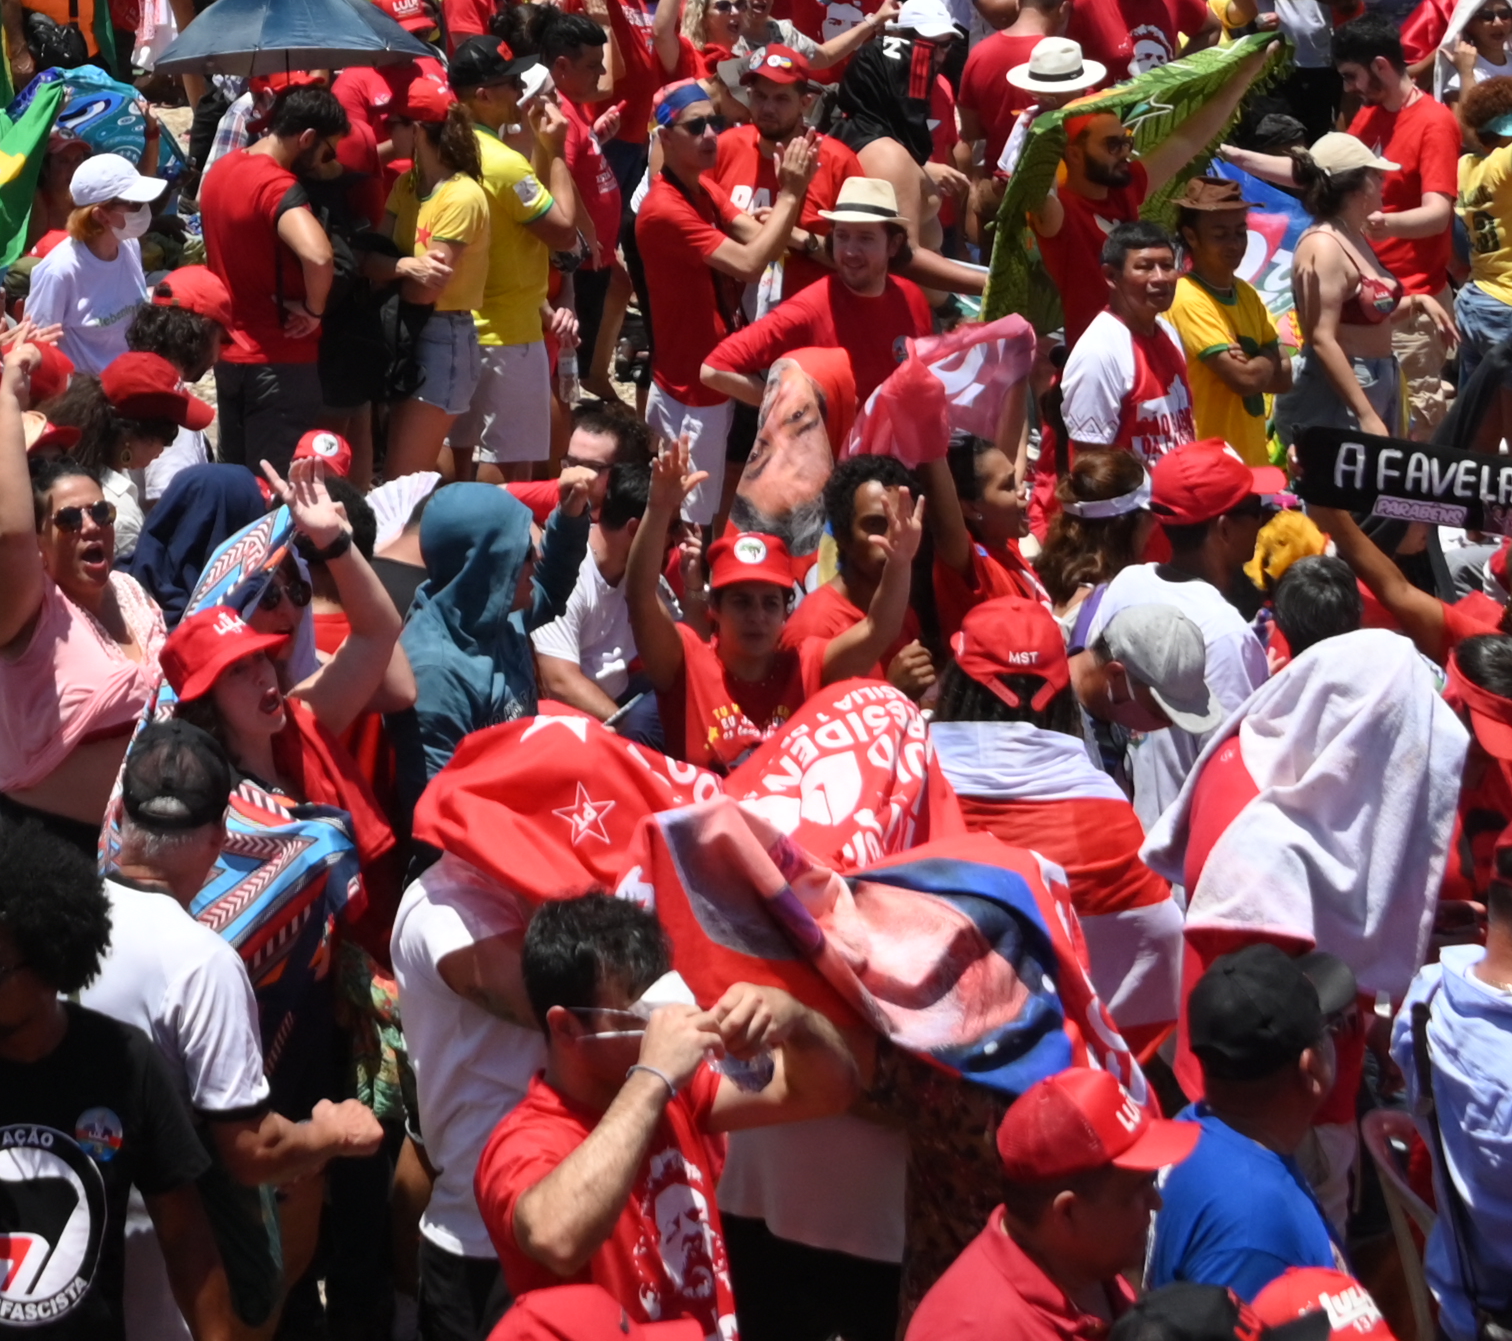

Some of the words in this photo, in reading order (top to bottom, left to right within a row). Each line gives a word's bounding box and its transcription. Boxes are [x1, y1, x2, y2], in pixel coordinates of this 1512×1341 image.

[1333, 441, 1367, 490] A
[1375, 496, 1465, 526] PARABÉNS
[1008, 650, 1040, 666] MST
[571, 801, 599, 833] PT
[1, 1126, 55, 1149] AÇÃO
[1317, 1283, 1384, 1332] LULA
